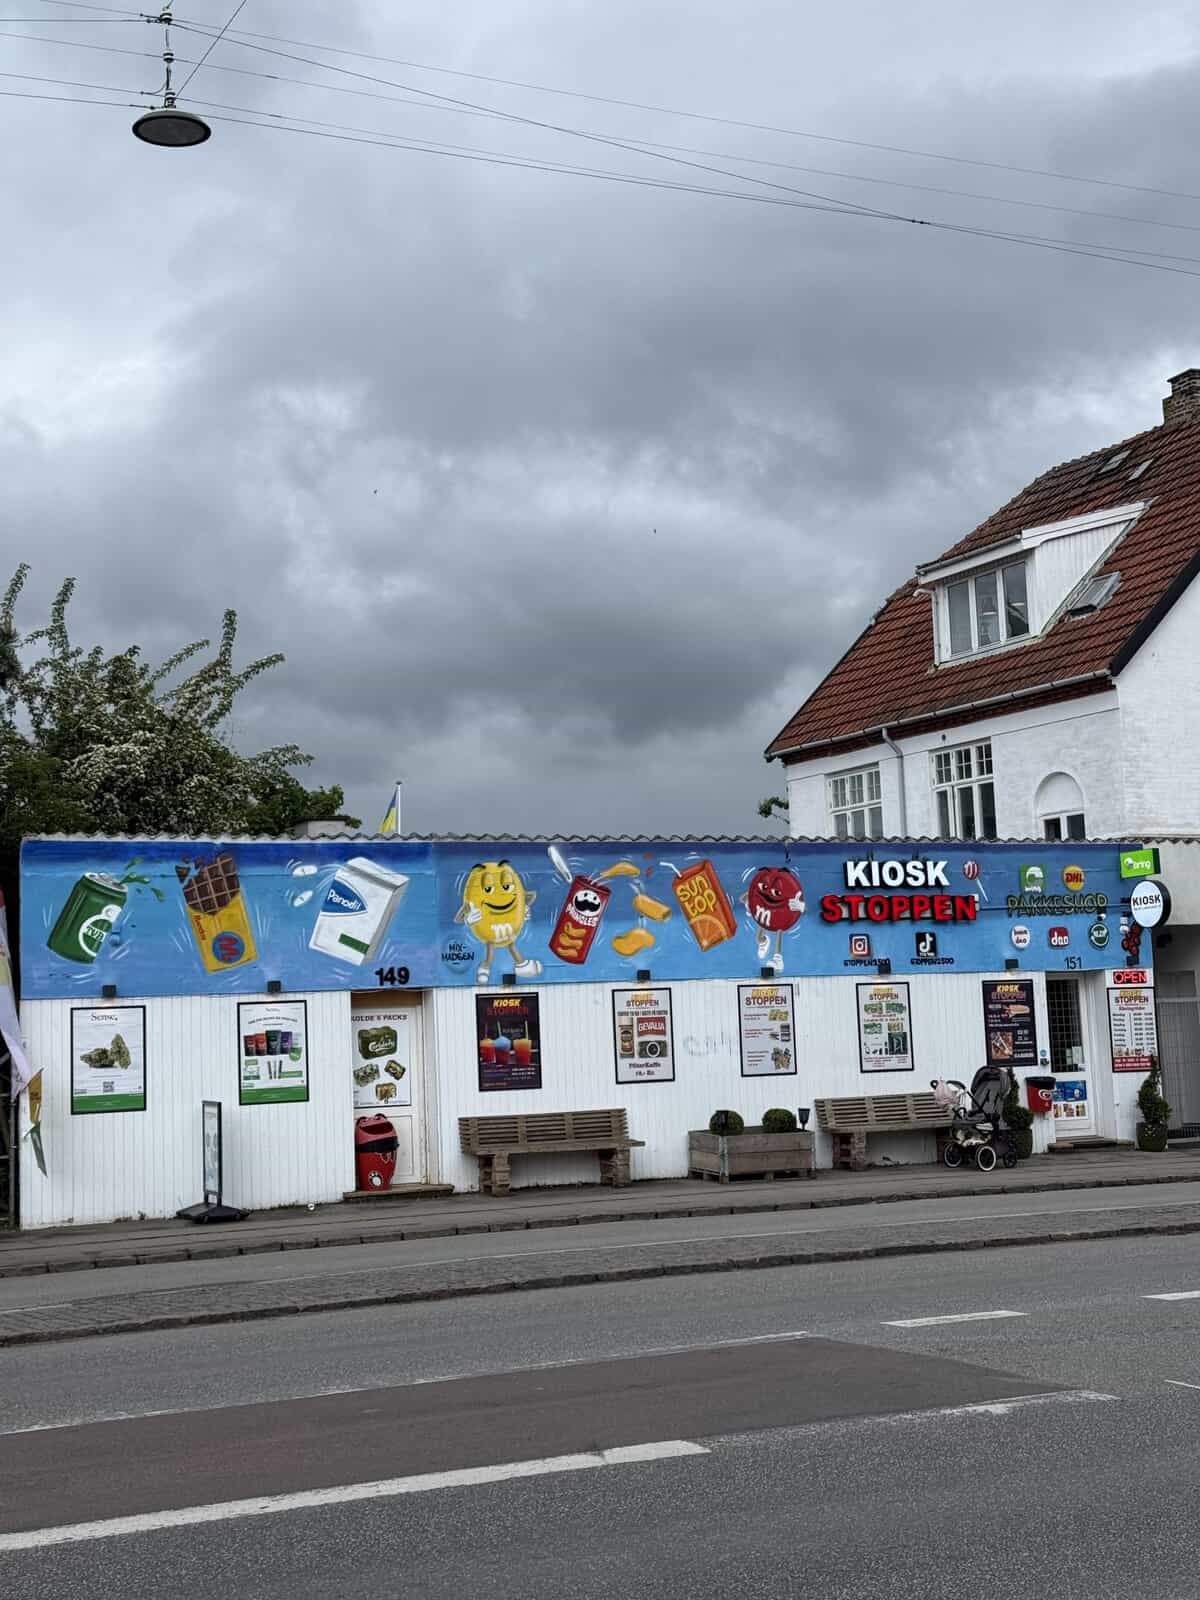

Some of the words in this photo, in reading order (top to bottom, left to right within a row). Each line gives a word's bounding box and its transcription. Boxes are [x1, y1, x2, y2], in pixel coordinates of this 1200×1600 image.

[846, 860, 950, 887] KIOSK
[327, 888, 361, 911] Panodil
[1007, 892, 1108, 915] PAKKESHOP
[1132, 895, 1161, 906] KIOSK
[822, 894, 977, 922] STOPPEN
[1064, 956, 1082, 969] 151
[375, 966, 410, 986] 149
[1114, 972, 1147, 984] OPEN
[745, 996, 787, 1006] STOPPEN
[869, 993, 898, 1001] STOPPEN
[1114, 996, 1149, 1004] STOPPEN
[492, 999, 521, 1008] KIOSK
[639, 1022, 665, 1032] GEVALIA
